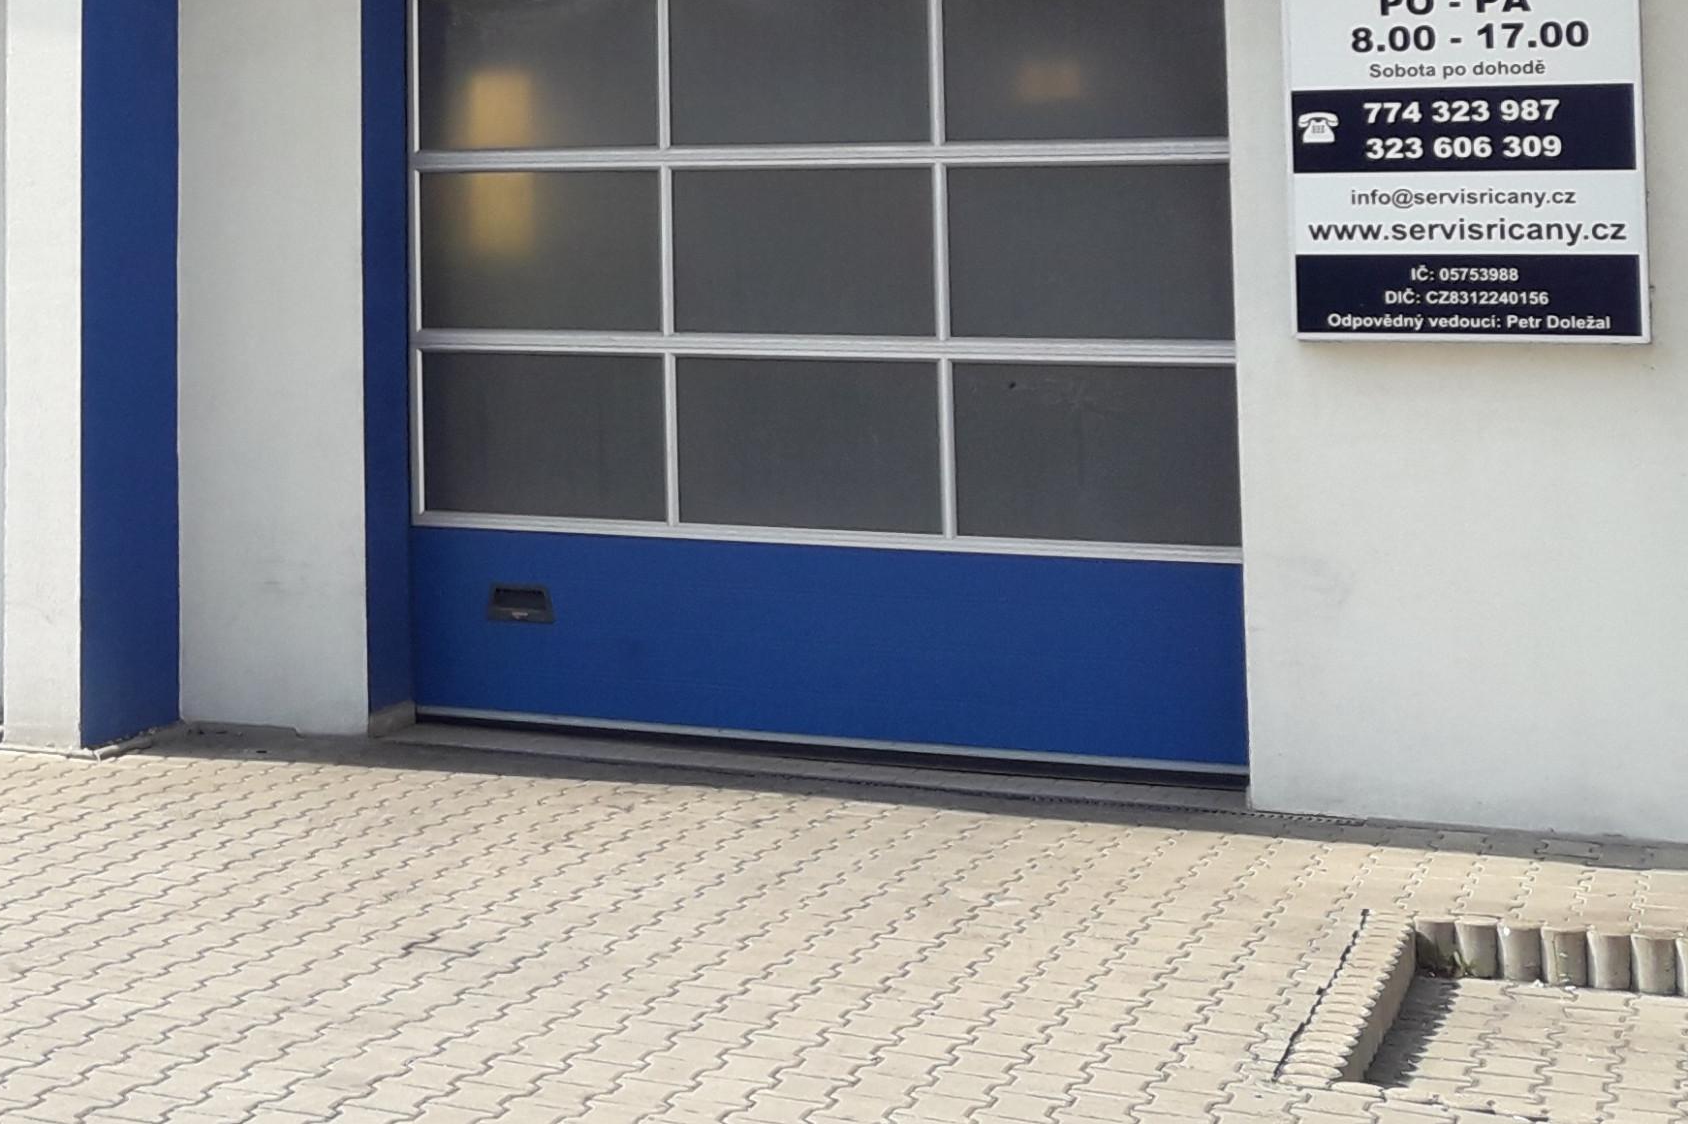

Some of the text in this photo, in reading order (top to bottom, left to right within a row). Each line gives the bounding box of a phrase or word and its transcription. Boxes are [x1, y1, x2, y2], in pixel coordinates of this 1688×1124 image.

[1351, 25, 1436, 53] 8.00
[1477, 20, 1589, 49] 17.00
[1369, 59, 1546, 80] Sobota po dohodě
[1363, 99, 1560, 124] 774 323 987
[1366, 135, 1562, 160] 323 606 309
[1351, 188, 1577, 209] info@servisricany.cz
[1308, 217, 1628, 247] www.servisricany.cz
[1411, 265, 1519, 282] IČ: 05753988
[1384, 289, 1549, 306] DIČ: CZ8312240156
[1327, 312, 1611, 331] Odpovědný vedoucí: Petr Doležal
